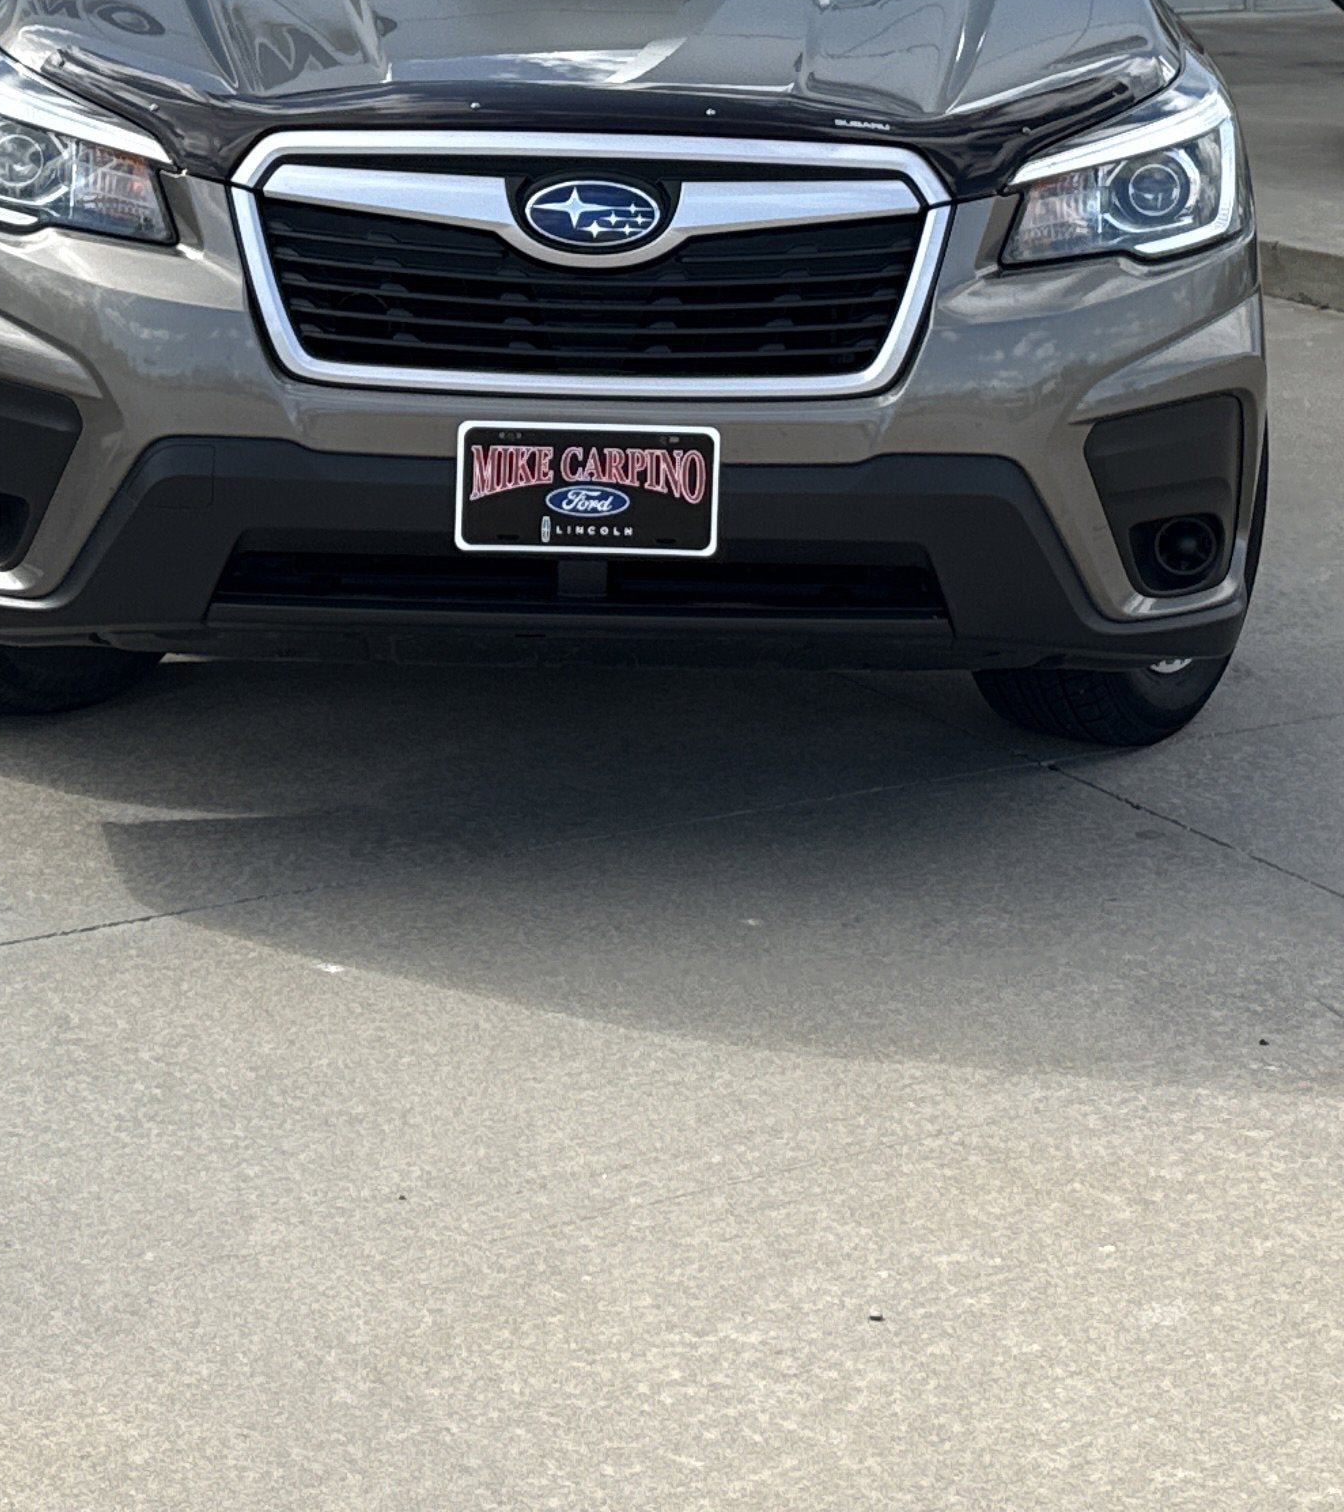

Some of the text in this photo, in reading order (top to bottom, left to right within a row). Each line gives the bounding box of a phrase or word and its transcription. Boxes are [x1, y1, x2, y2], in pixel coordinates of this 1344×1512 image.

[469, 445, 706, 504] MIKE CARPINO
[560, 489, 614, 513] Ford
[555, 524, 633, 537] LINCOLN
